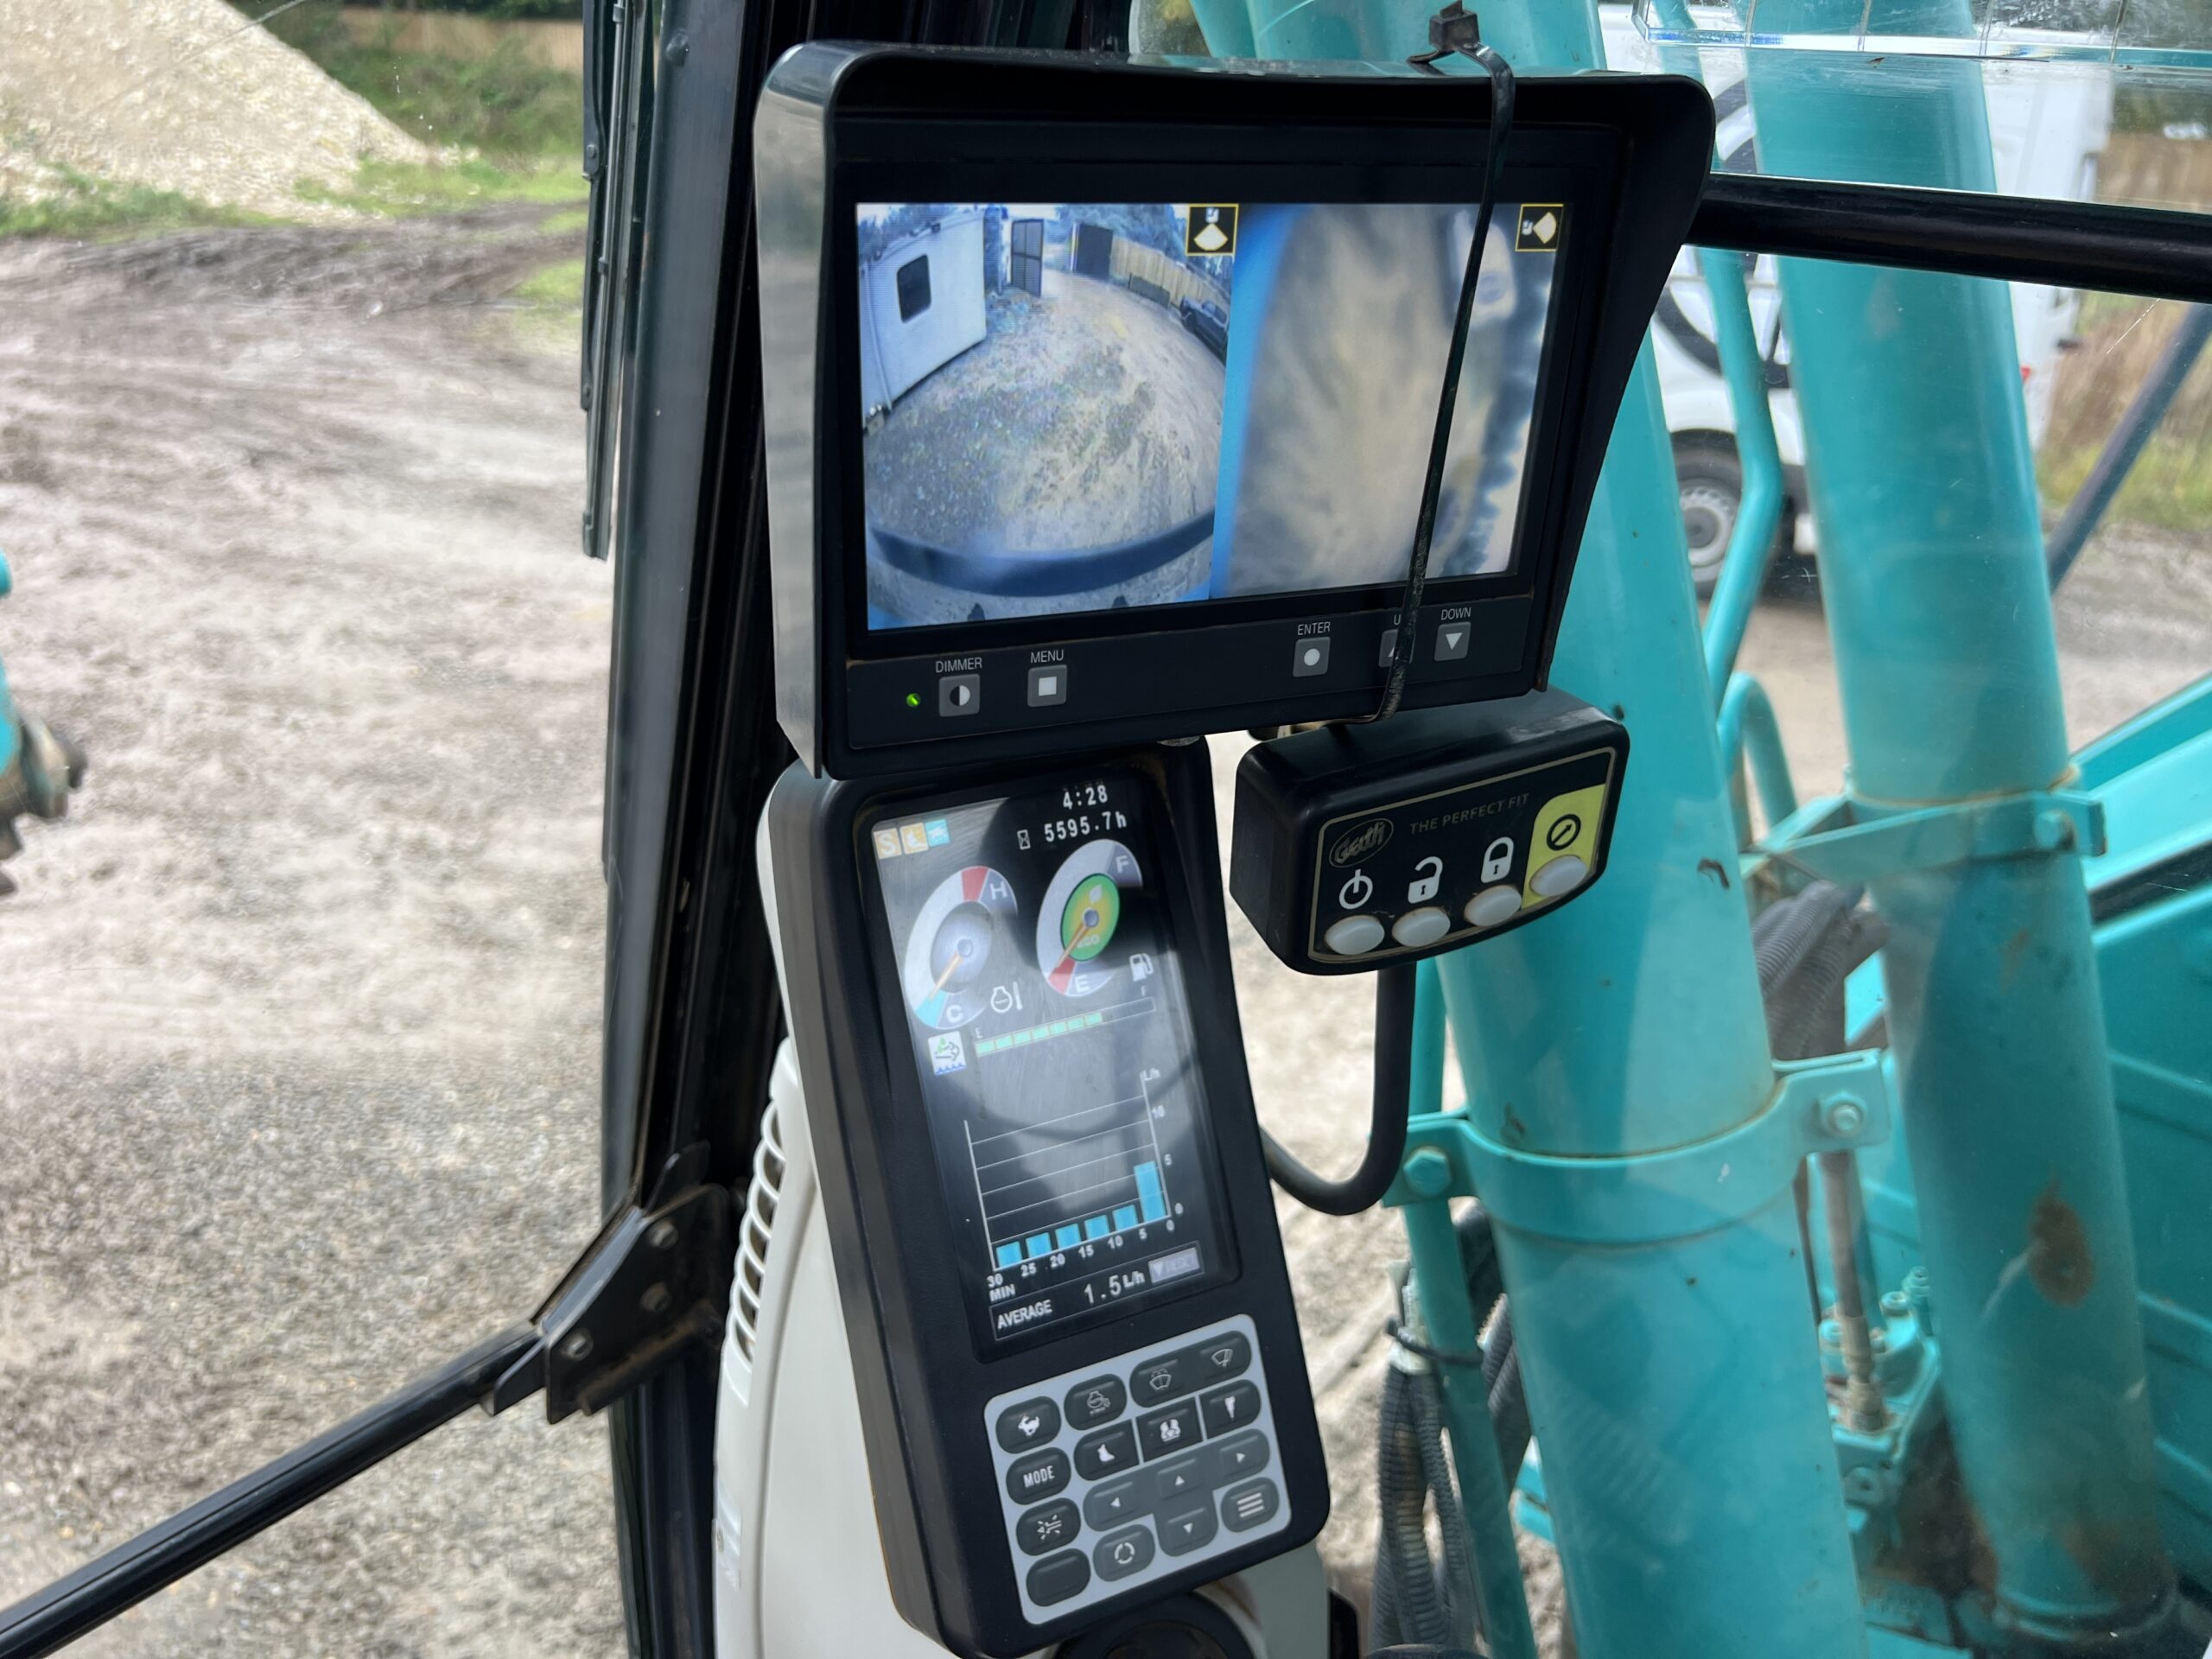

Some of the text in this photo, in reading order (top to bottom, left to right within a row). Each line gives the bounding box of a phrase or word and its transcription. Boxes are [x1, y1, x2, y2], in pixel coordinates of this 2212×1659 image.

[1440, 607, 1471, 620] DOWN
[1297, 621, 1331, 636] ENTER
[935, 657, 982, 673] DIMMER
[1030, 650, 1065, 664] MENU
[1062, 785, 1108, 810] 4:28
[1409, 792, 1530, 836] THE PERFECT FIT
[879, 830, 897, 856] S
[1116, 855, 1128, 873] F
[989, 881, 1007, 899] H
[1075, 975, 1090, 993] E
[946, 1005, 963, 1023] C
[987, 1273, 1003, 1288] 30
[1020, 1262, 1037, 1278] 25
[1050, 1253, 1066, 1268] 20
[1078, 1244, 1094, 1259] 15
[1107, 1235, 1123, 1249] 10
[1138, 1228, 1147, 1240] 5
[989, 1284, 1016, 1302] MIN
[997, 1299, 1052, 1331] AVERAGE
[1023, 1465, 1055, 1488] MODE
